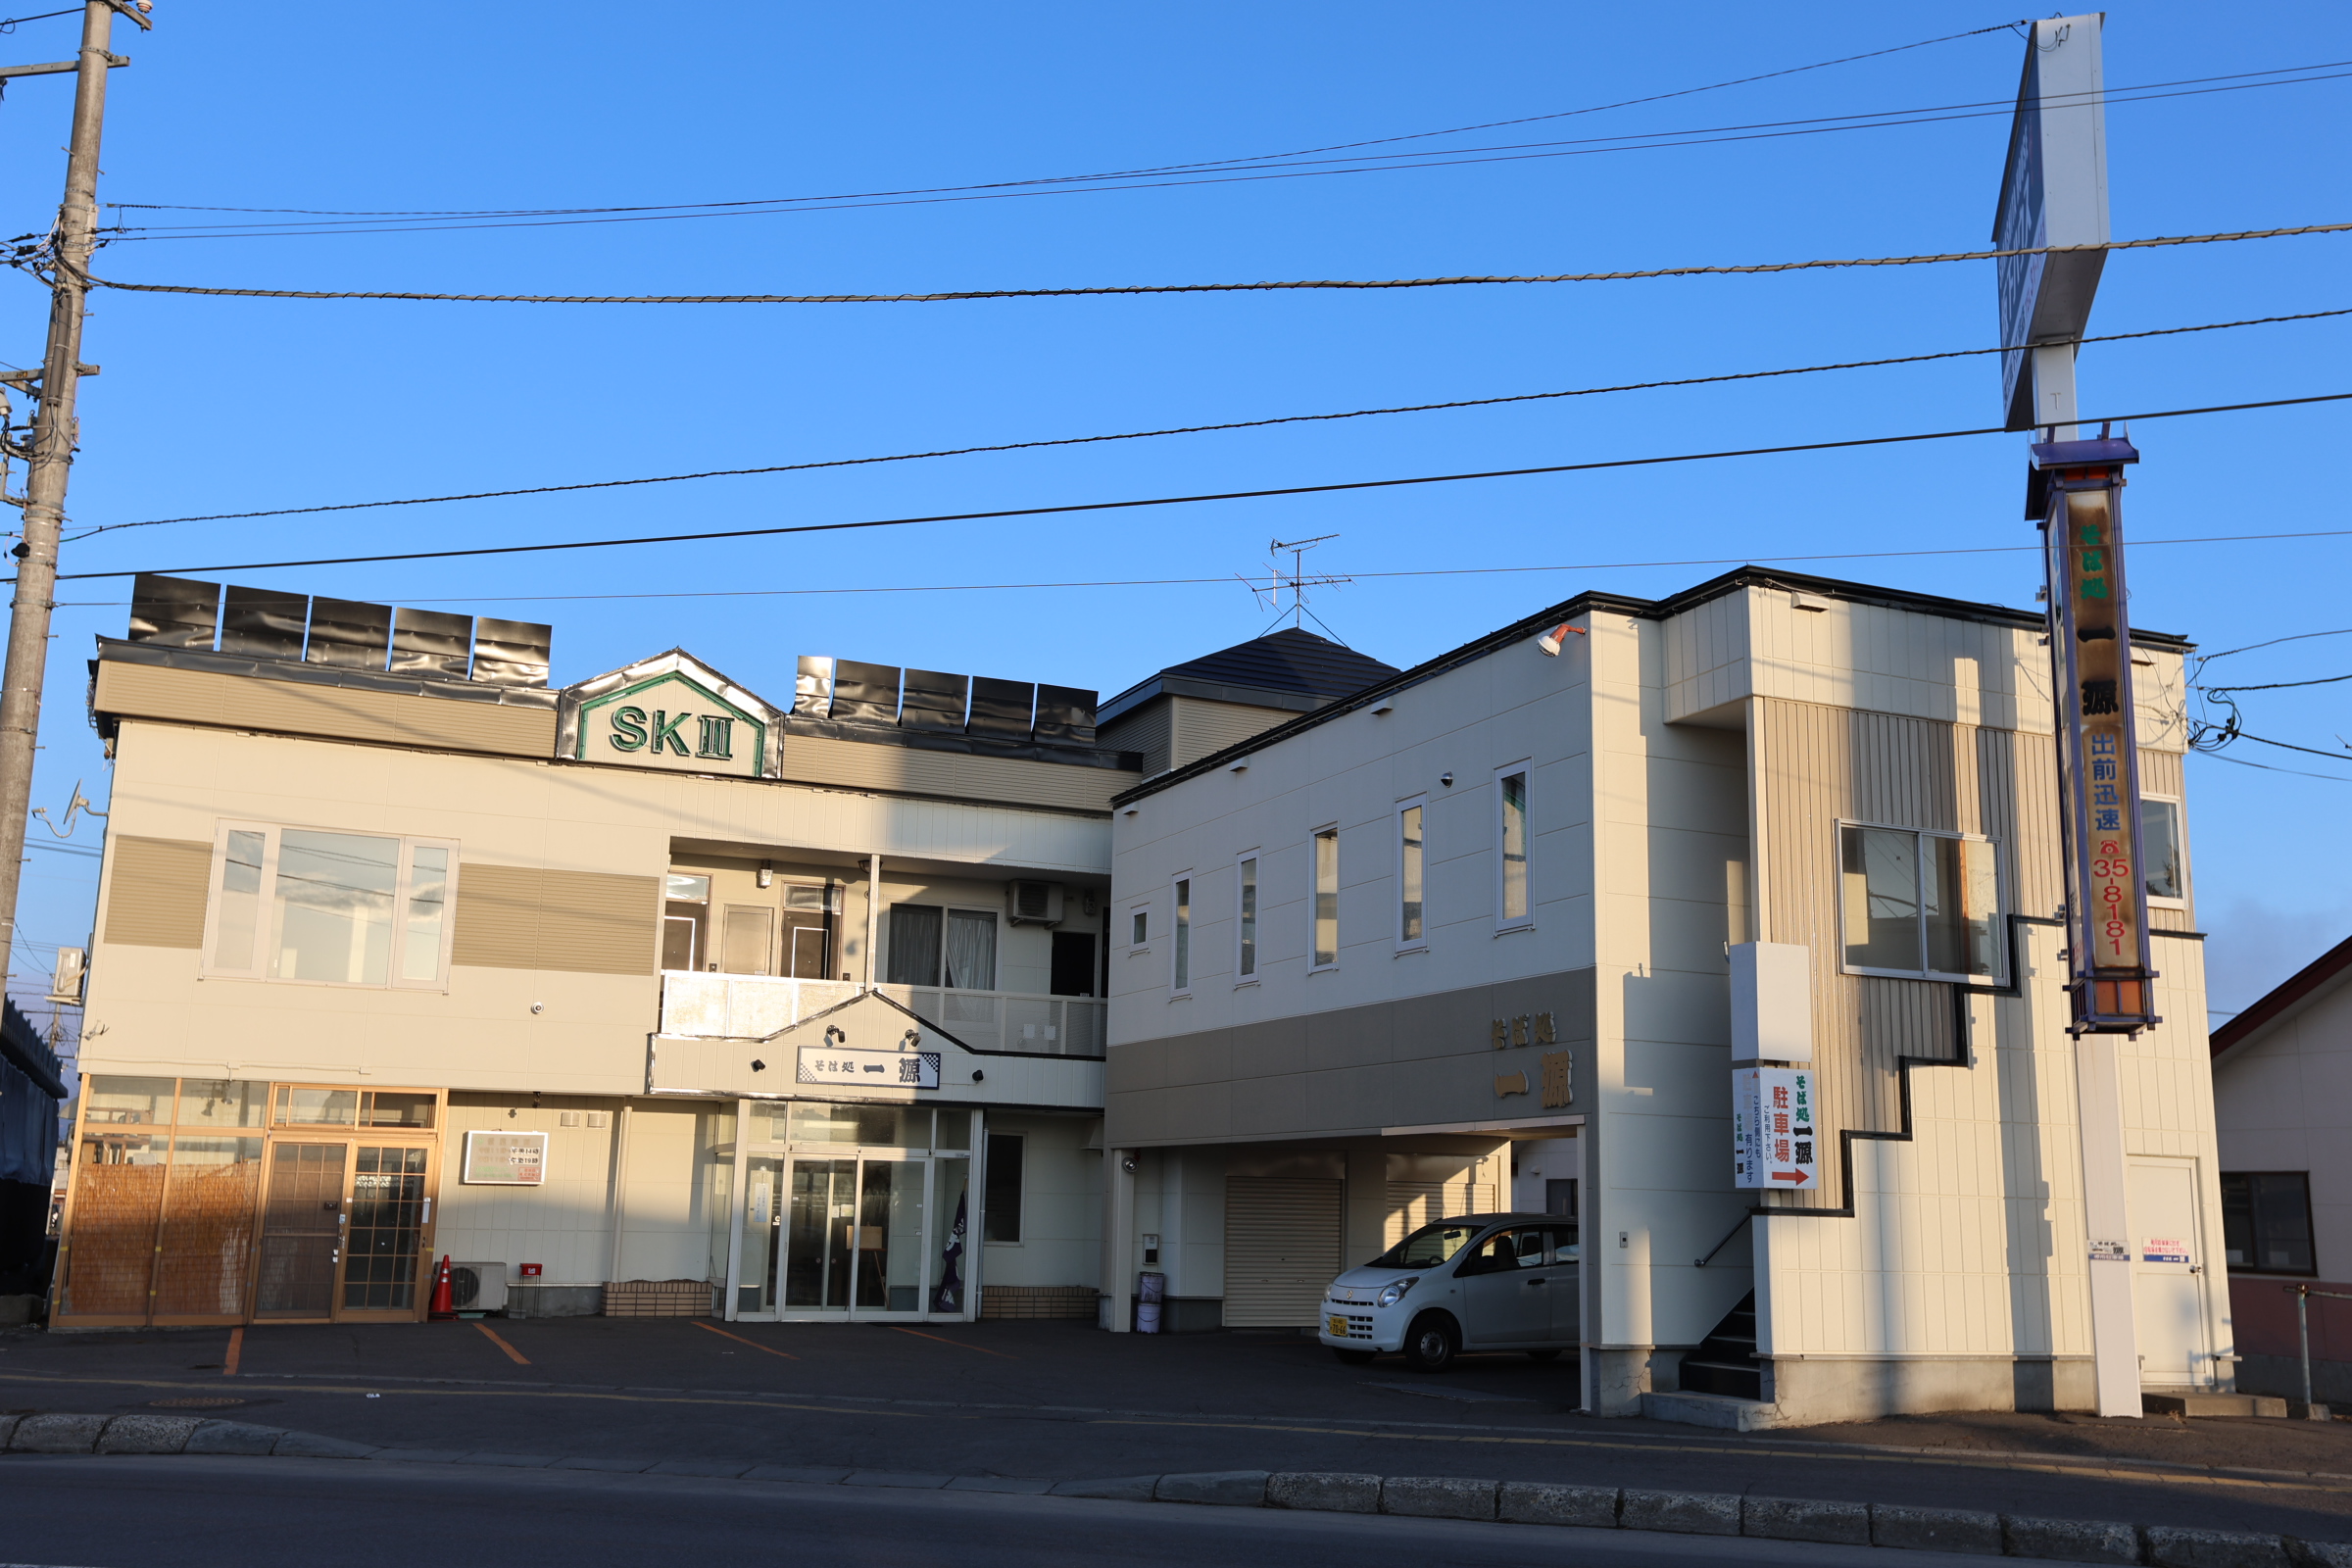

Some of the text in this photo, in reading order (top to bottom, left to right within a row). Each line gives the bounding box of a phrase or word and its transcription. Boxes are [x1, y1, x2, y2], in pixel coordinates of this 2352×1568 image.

[2077, 524, 2119, 716] そば処 一源
[2090, 733, 2121, 831] 出前迅速
[2093, 858, 2130, 956] 35-8181
[815, 1057, 921, 1083] そば処 一源
[1492, 1011, 1556, 1049] そば処
[1494, 1050, 1573, 1108] 一源
[1792, 1075, 1813, 1164] そば処 一源
[1773, 1086, 1790, 1163] 駐車場
